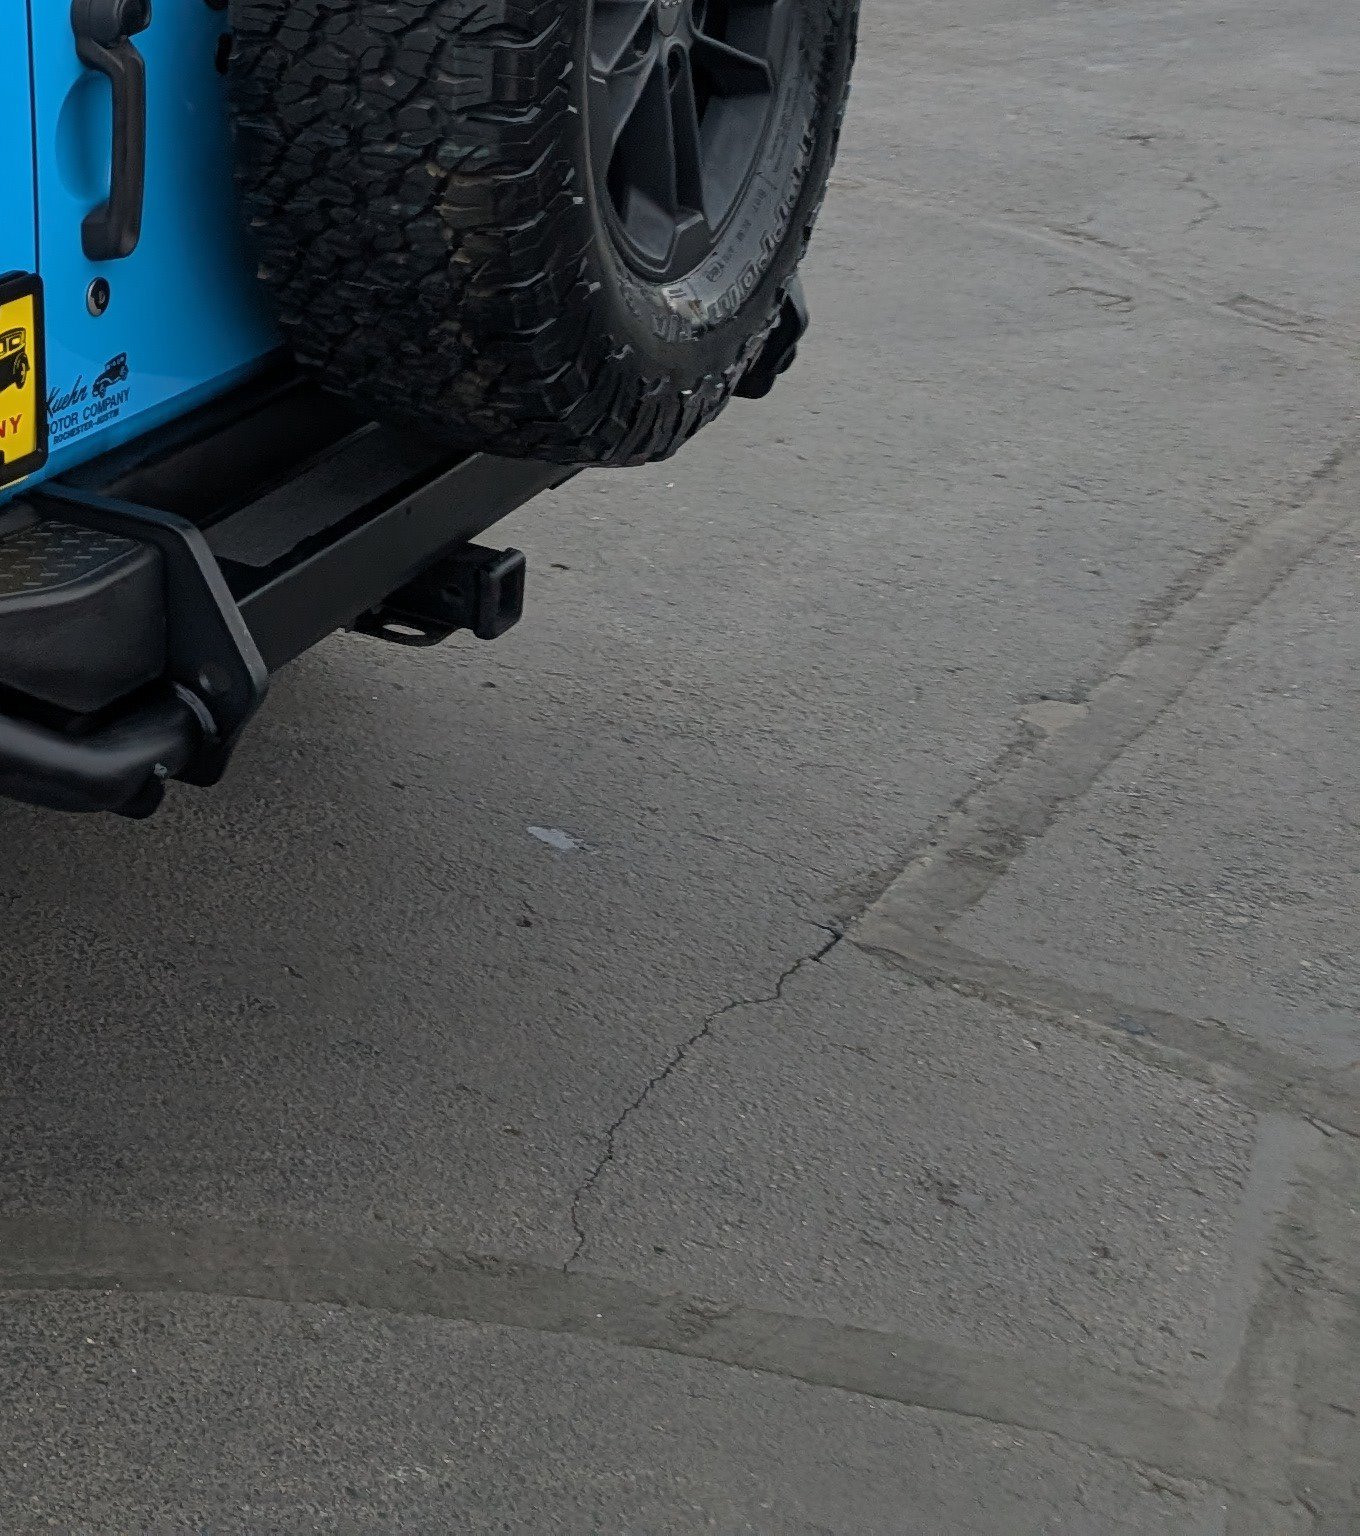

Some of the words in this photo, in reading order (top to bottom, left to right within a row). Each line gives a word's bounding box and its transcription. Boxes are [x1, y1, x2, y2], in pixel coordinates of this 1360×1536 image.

[47, 374, 87, 418] Kuehn
[49, 411, 78, 434] OTOR
[83, 386, 130, 420] COMPANY
